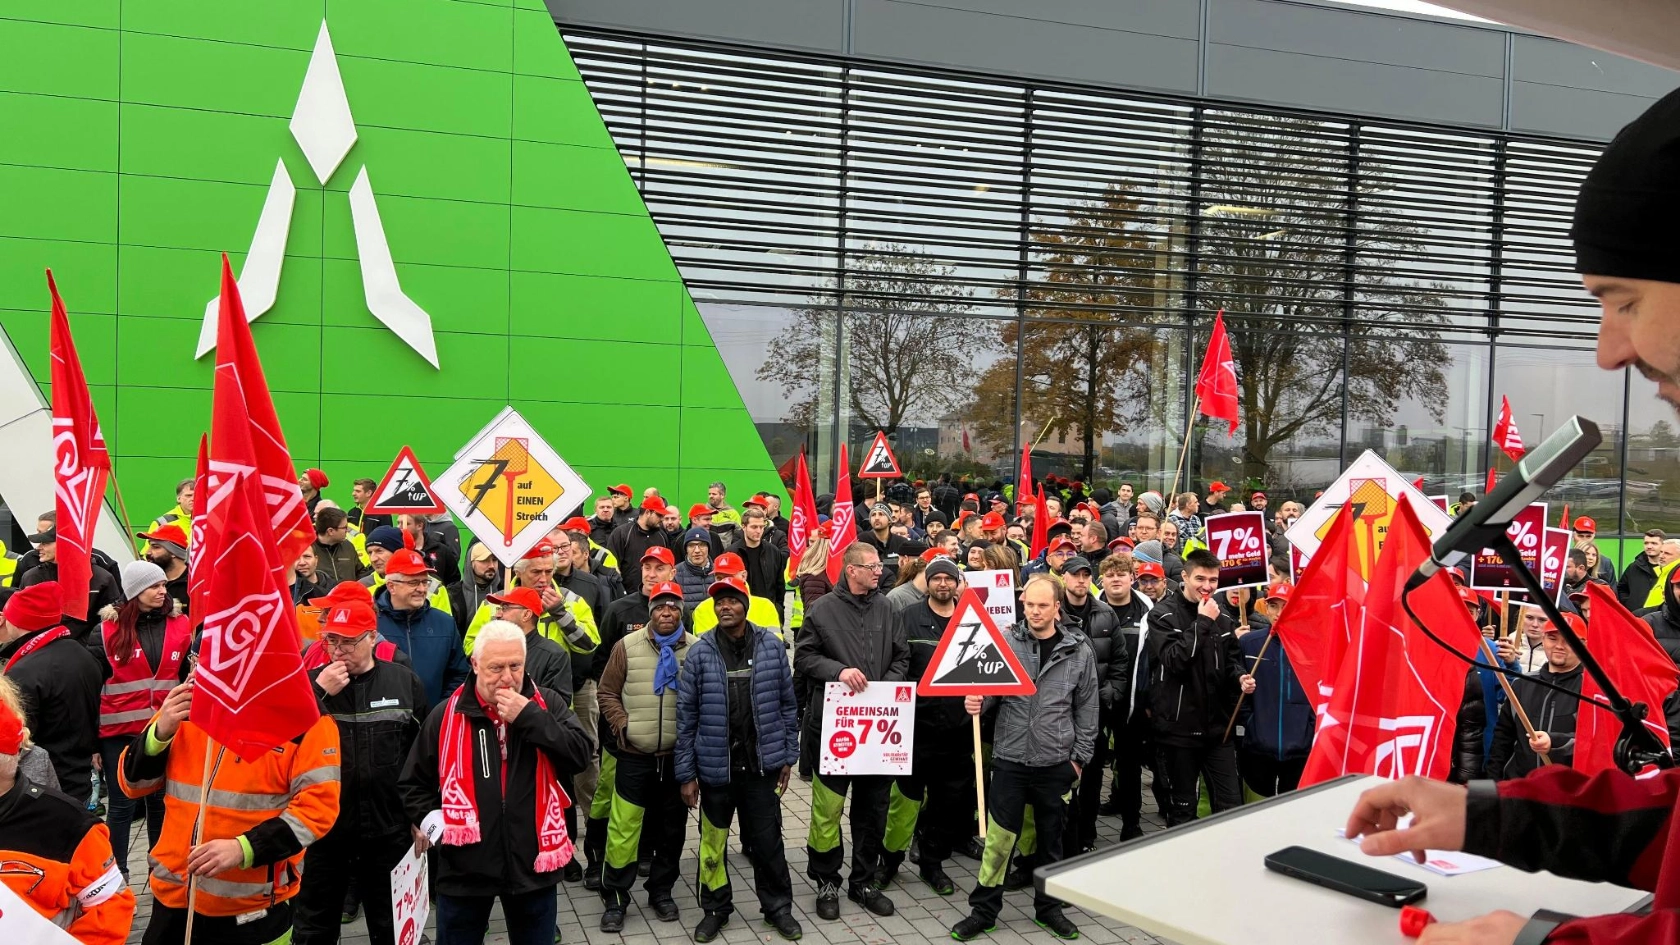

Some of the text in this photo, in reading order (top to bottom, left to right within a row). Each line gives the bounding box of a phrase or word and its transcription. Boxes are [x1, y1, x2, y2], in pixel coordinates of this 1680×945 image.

[517, 481, 533, 490] auf
[412, 492, 427, 502] UP
[516, 496, 544, 506] EINEN
[516, 511, 548, 521] Streich
[1245, 550, 1261, 558] Geld
[170, 650, 181, 661] 8!
[984, 661, 1005, 674] UP
[836, 706, 899, 716] GEMEINSAM
[835, 717, 855, 728] FÜR
